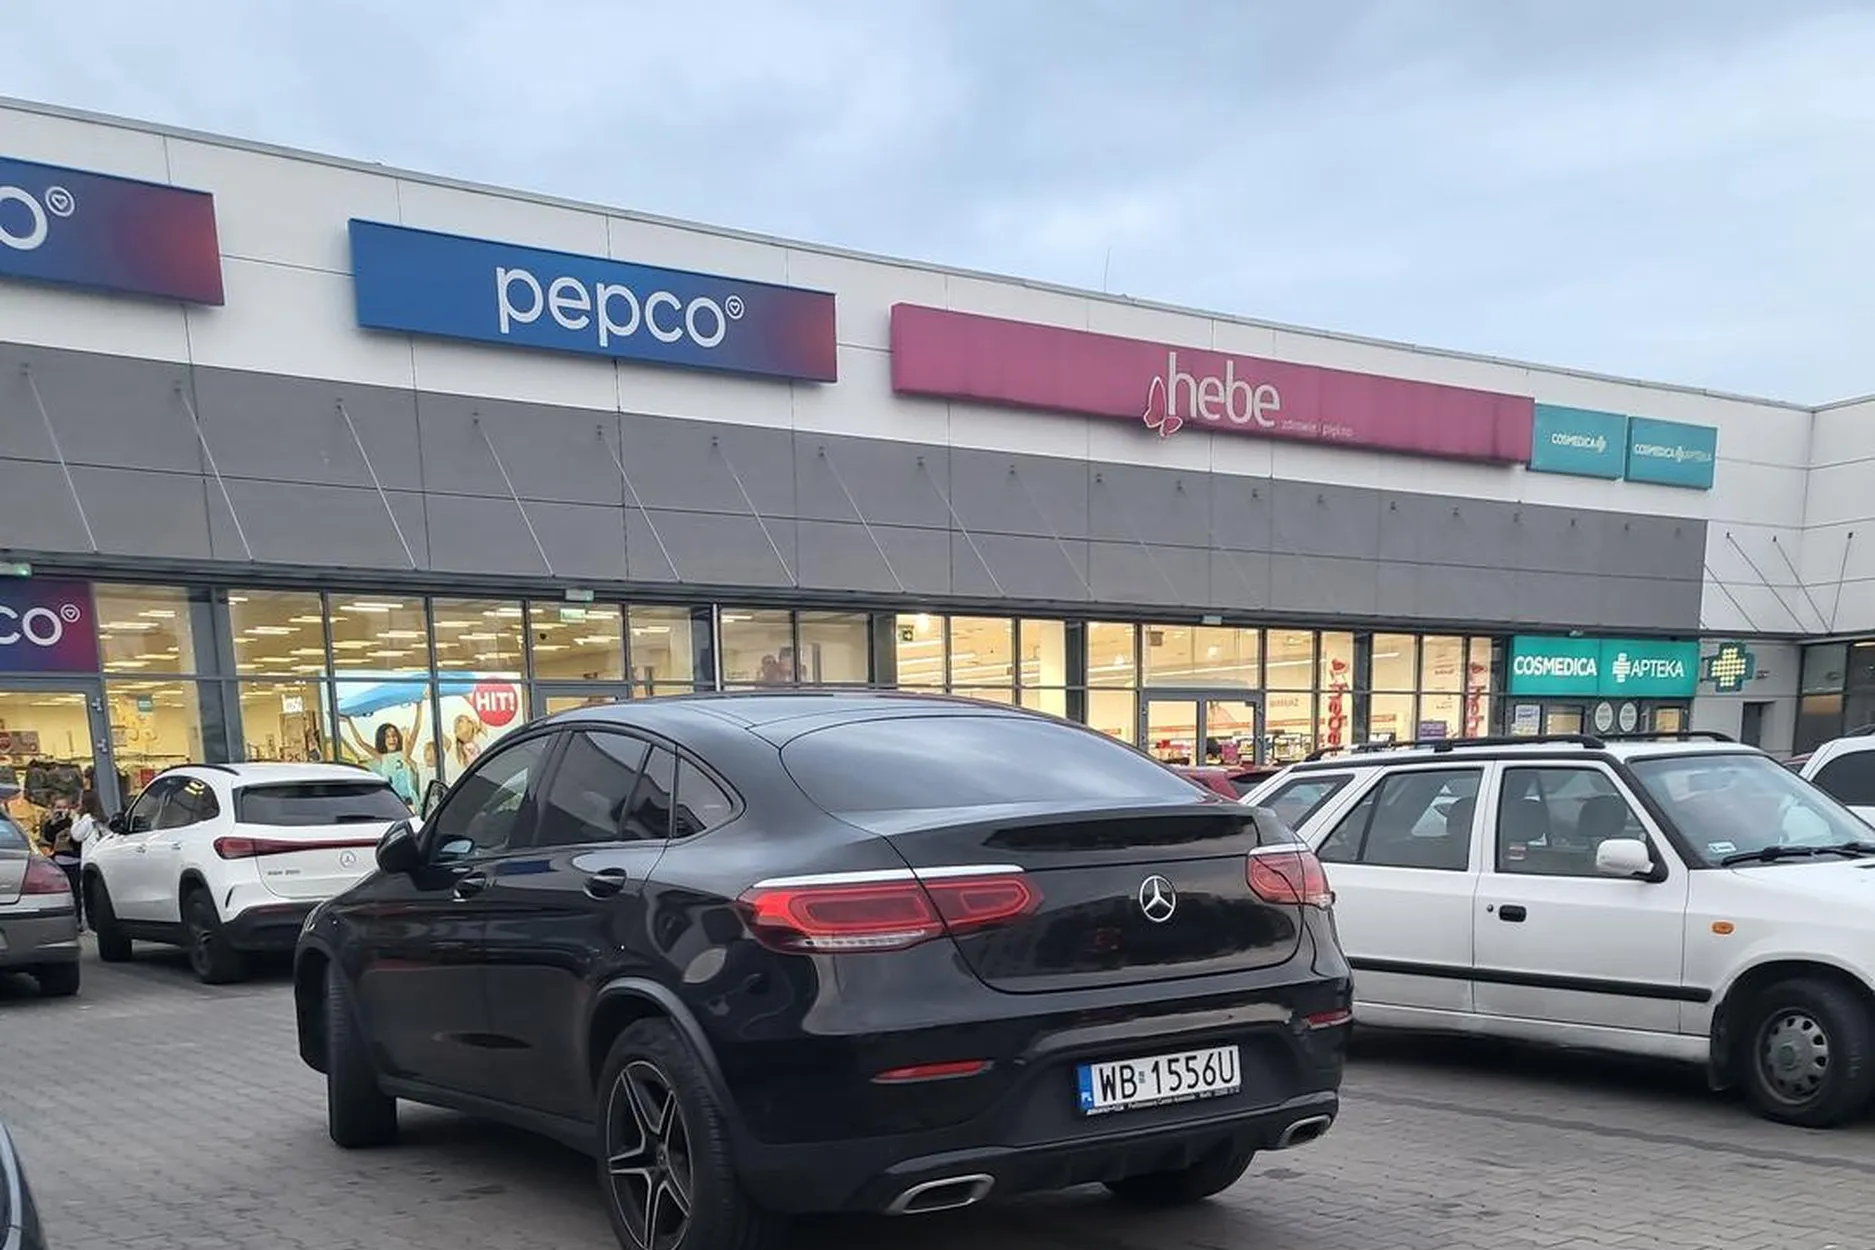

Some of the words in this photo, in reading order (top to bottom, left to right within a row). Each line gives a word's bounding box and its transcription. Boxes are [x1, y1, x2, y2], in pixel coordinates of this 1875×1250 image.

[496, 266, 726, 348] pepco
[1167, 351, 1281, 428] hebe
[1551, 432, 1595, 449] COSMEDICA
[1513, 655, 1598, 677] COSMEDICA
[1629, 658, 1685, 679] APTEKA
[475, 690, 516, 713] HIT!
[1327, 681, 1348, 746] hebe
[1100, 1063, 1138, 1102] WB
[1151, 1049, 1235, 1095] 1556U
